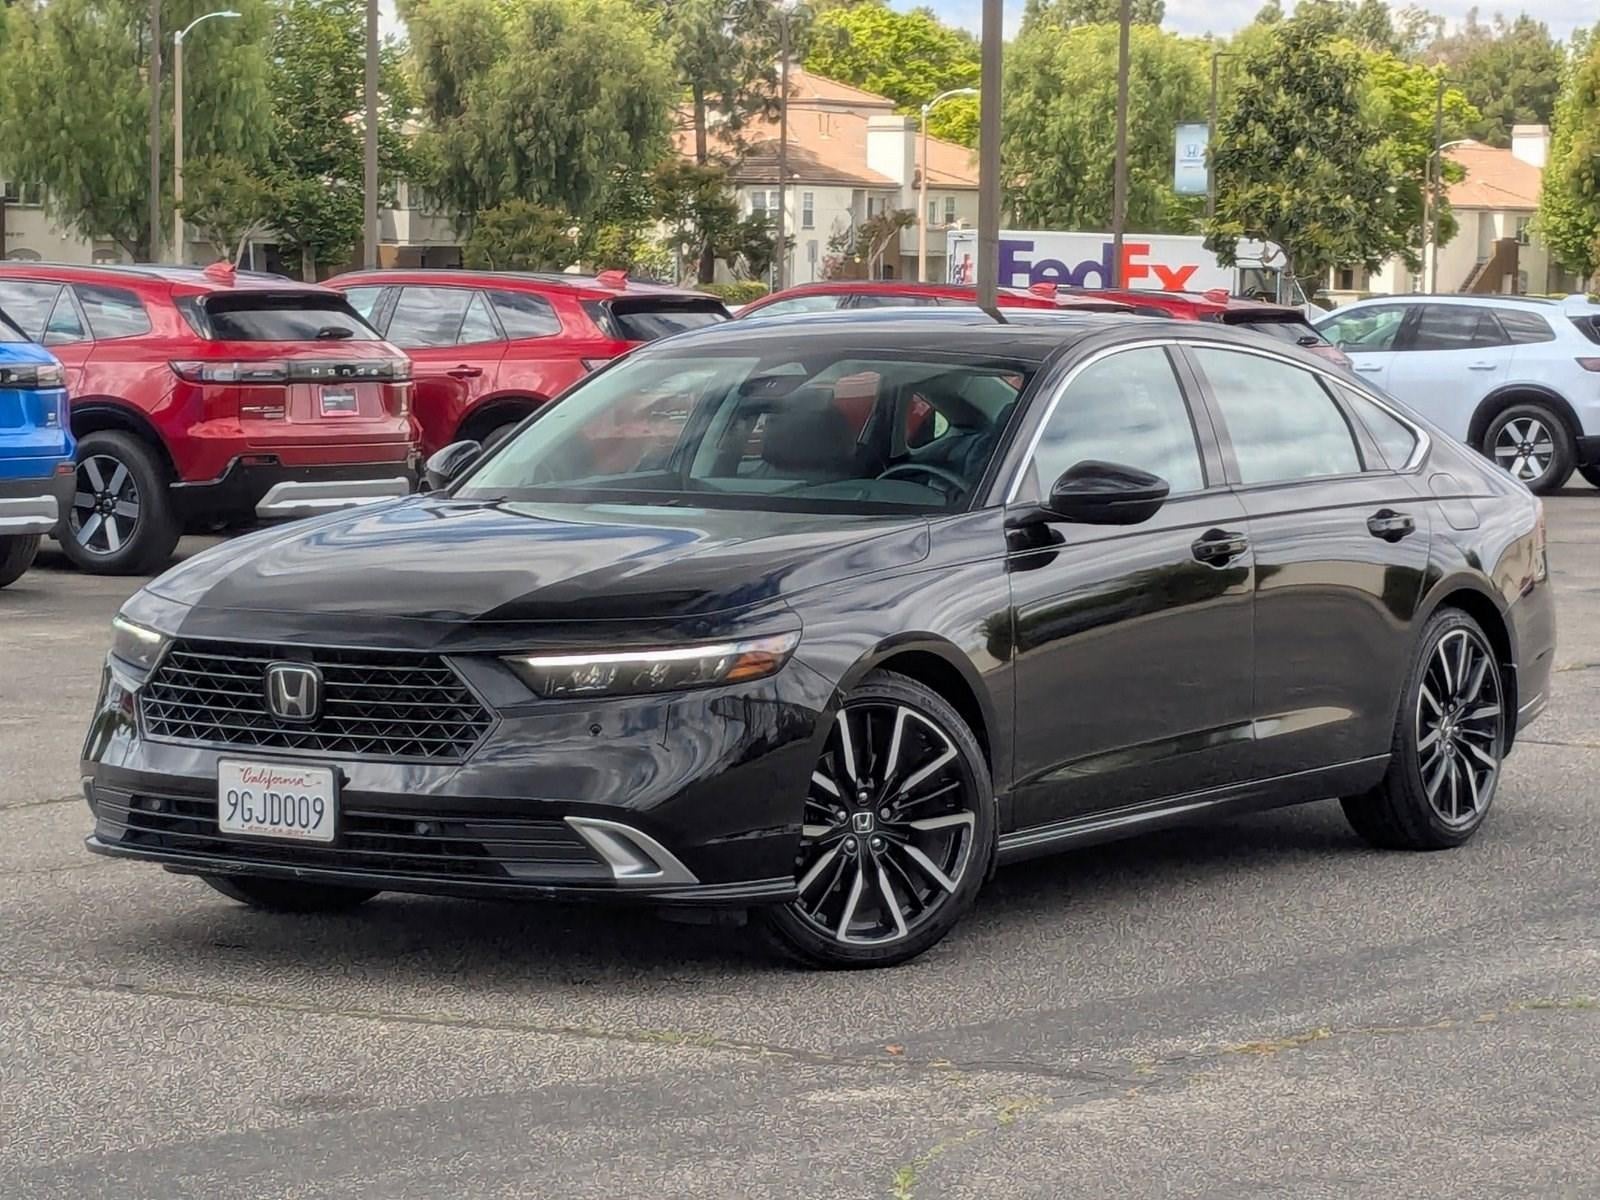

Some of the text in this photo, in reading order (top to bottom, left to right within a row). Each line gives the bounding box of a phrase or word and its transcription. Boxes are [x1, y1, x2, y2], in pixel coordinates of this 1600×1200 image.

[998, 240, 1199, 291] FedEx
[242, 767, 312, 789] California
[226, 789, 325, 830] 9GJD009
